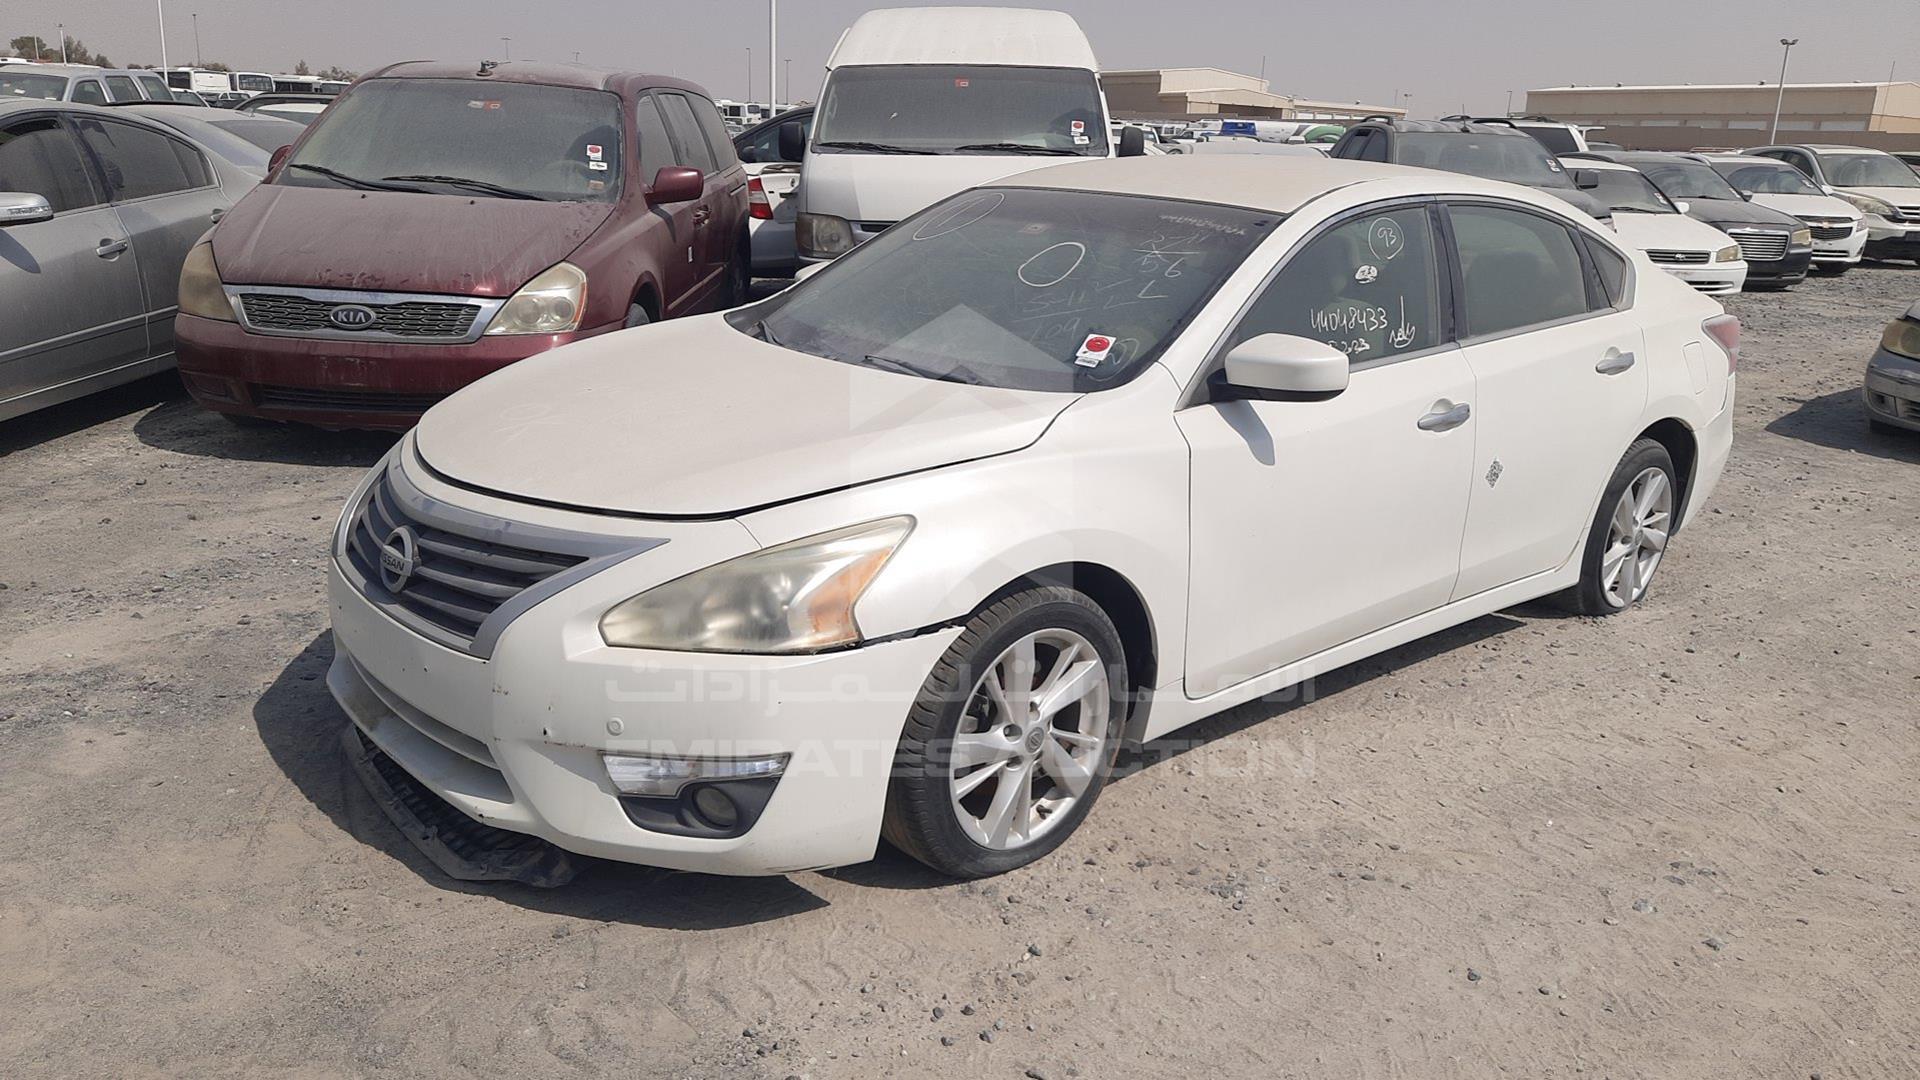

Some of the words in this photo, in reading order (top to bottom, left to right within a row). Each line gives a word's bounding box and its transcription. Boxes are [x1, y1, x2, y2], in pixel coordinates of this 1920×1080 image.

[1377, 227, 1397, 247] 93
[337, 311, 366, 323] KIA
[1310, 307, 1388, 334] 44048433
